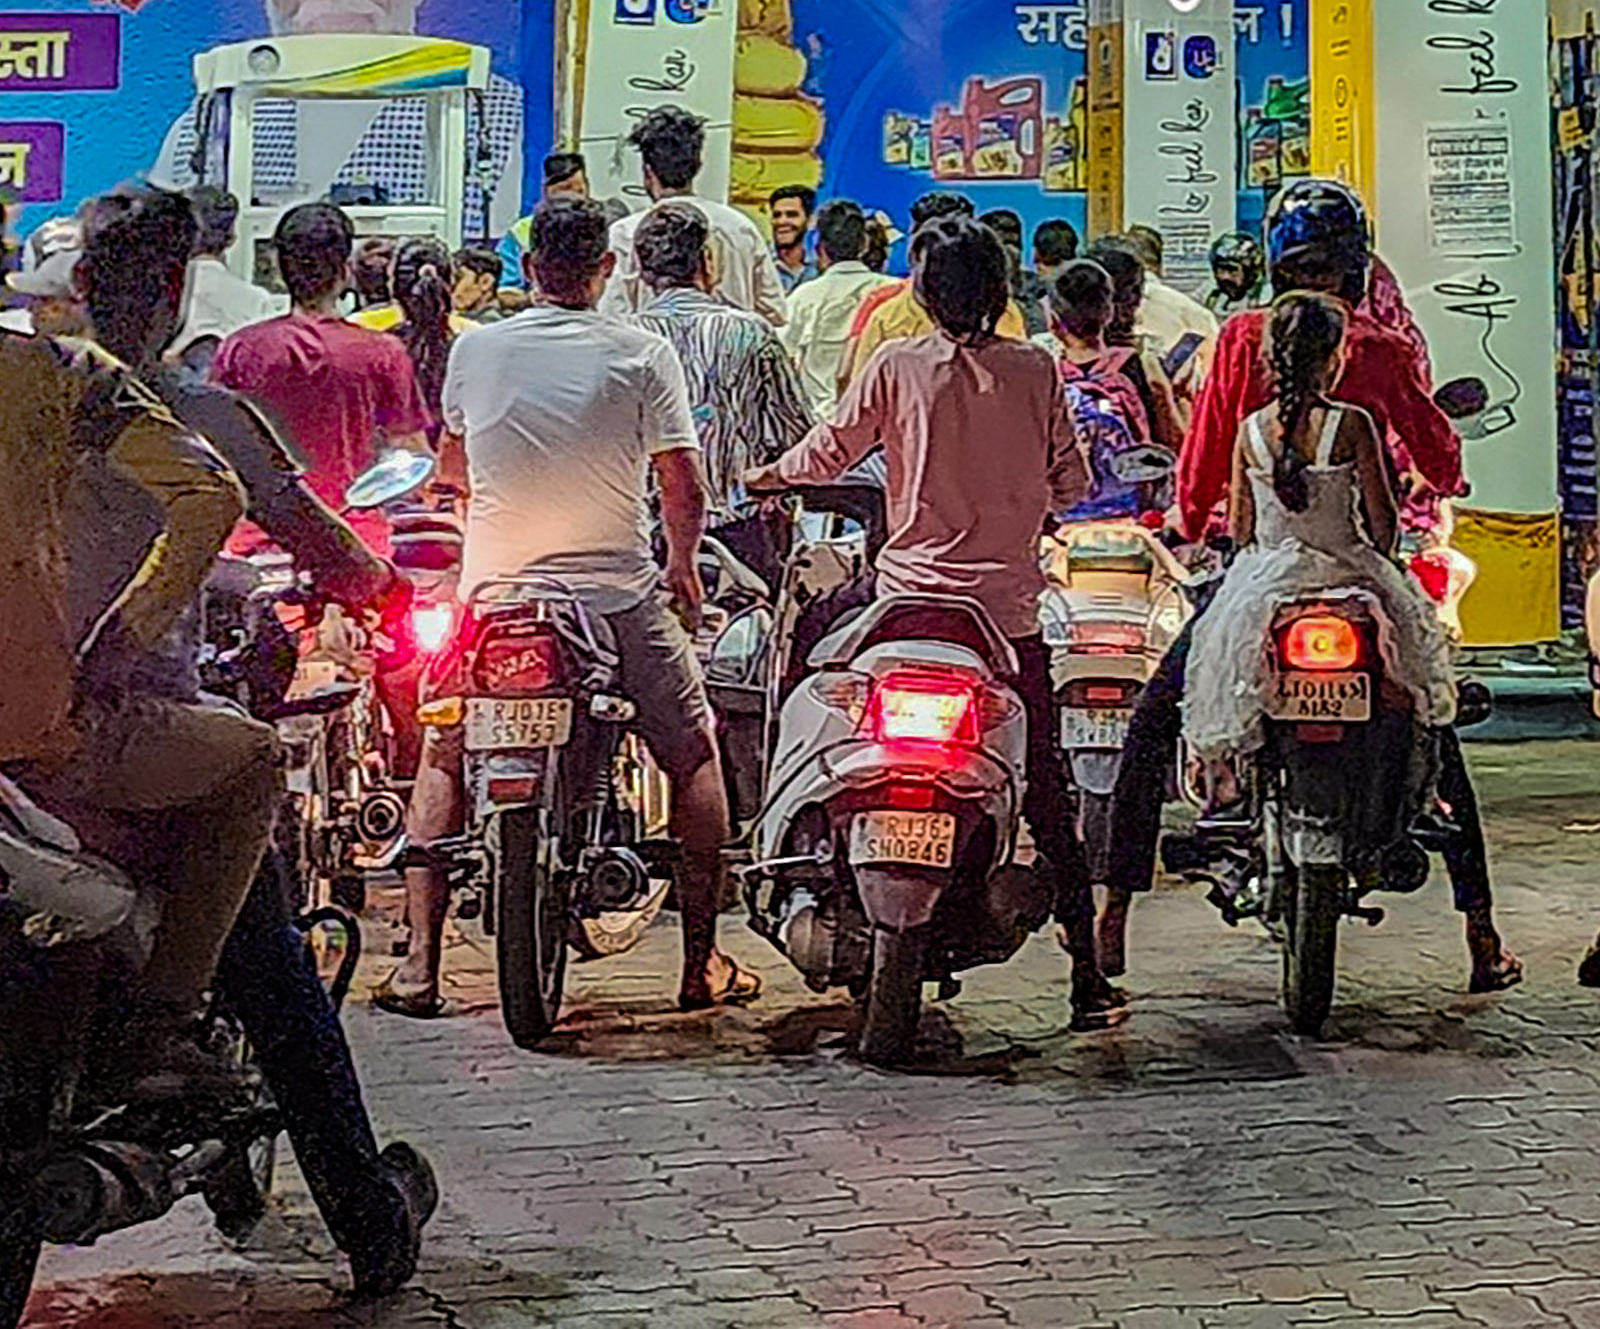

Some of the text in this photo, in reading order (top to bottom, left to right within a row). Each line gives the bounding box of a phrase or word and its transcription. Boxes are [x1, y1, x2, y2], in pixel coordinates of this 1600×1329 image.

[1426, 30, 1519, 95] feel
[886, 816, 940, 840] RJ36
[867, 838, 947, 863] SH0846
